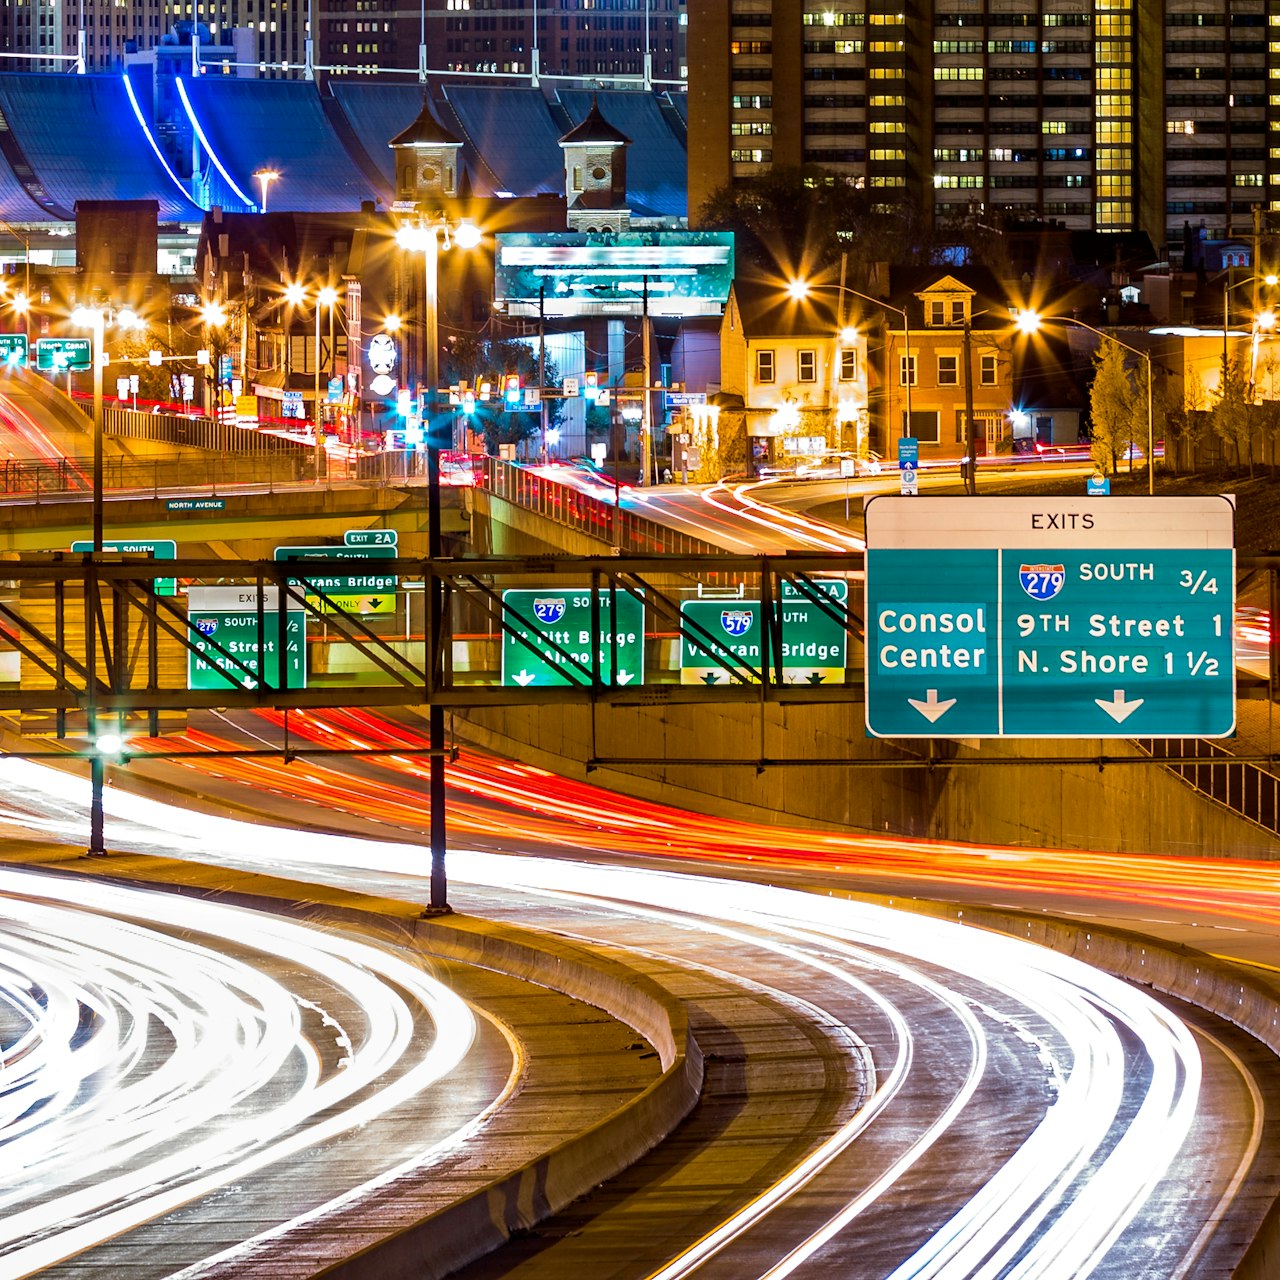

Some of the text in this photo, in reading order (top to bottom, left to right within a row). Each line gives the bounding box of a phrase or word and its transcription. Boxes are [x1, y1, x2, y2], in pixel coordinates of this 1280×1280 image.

[1032, 514, 1095, 529] EXITS
[375, 534, 391, 543] 2A
[348, 576, 393, 589] Bridge
[1027, 574, 1062, 594] 279
[1080, 564, 1154, 580] SOUTH
[538, 605, 563, 616] 279
[727, 618, 751, 631] 579
[879, 609, 986, 634] Consol
[1017, 614, 1222, 637] 9TH Street 1
[880, 645, 985, 668] Center
[1018, 650, 1049, 673] N.
[1061, 650, 1148, 673] Shore
[1165, 652, 1173, 675] 1
